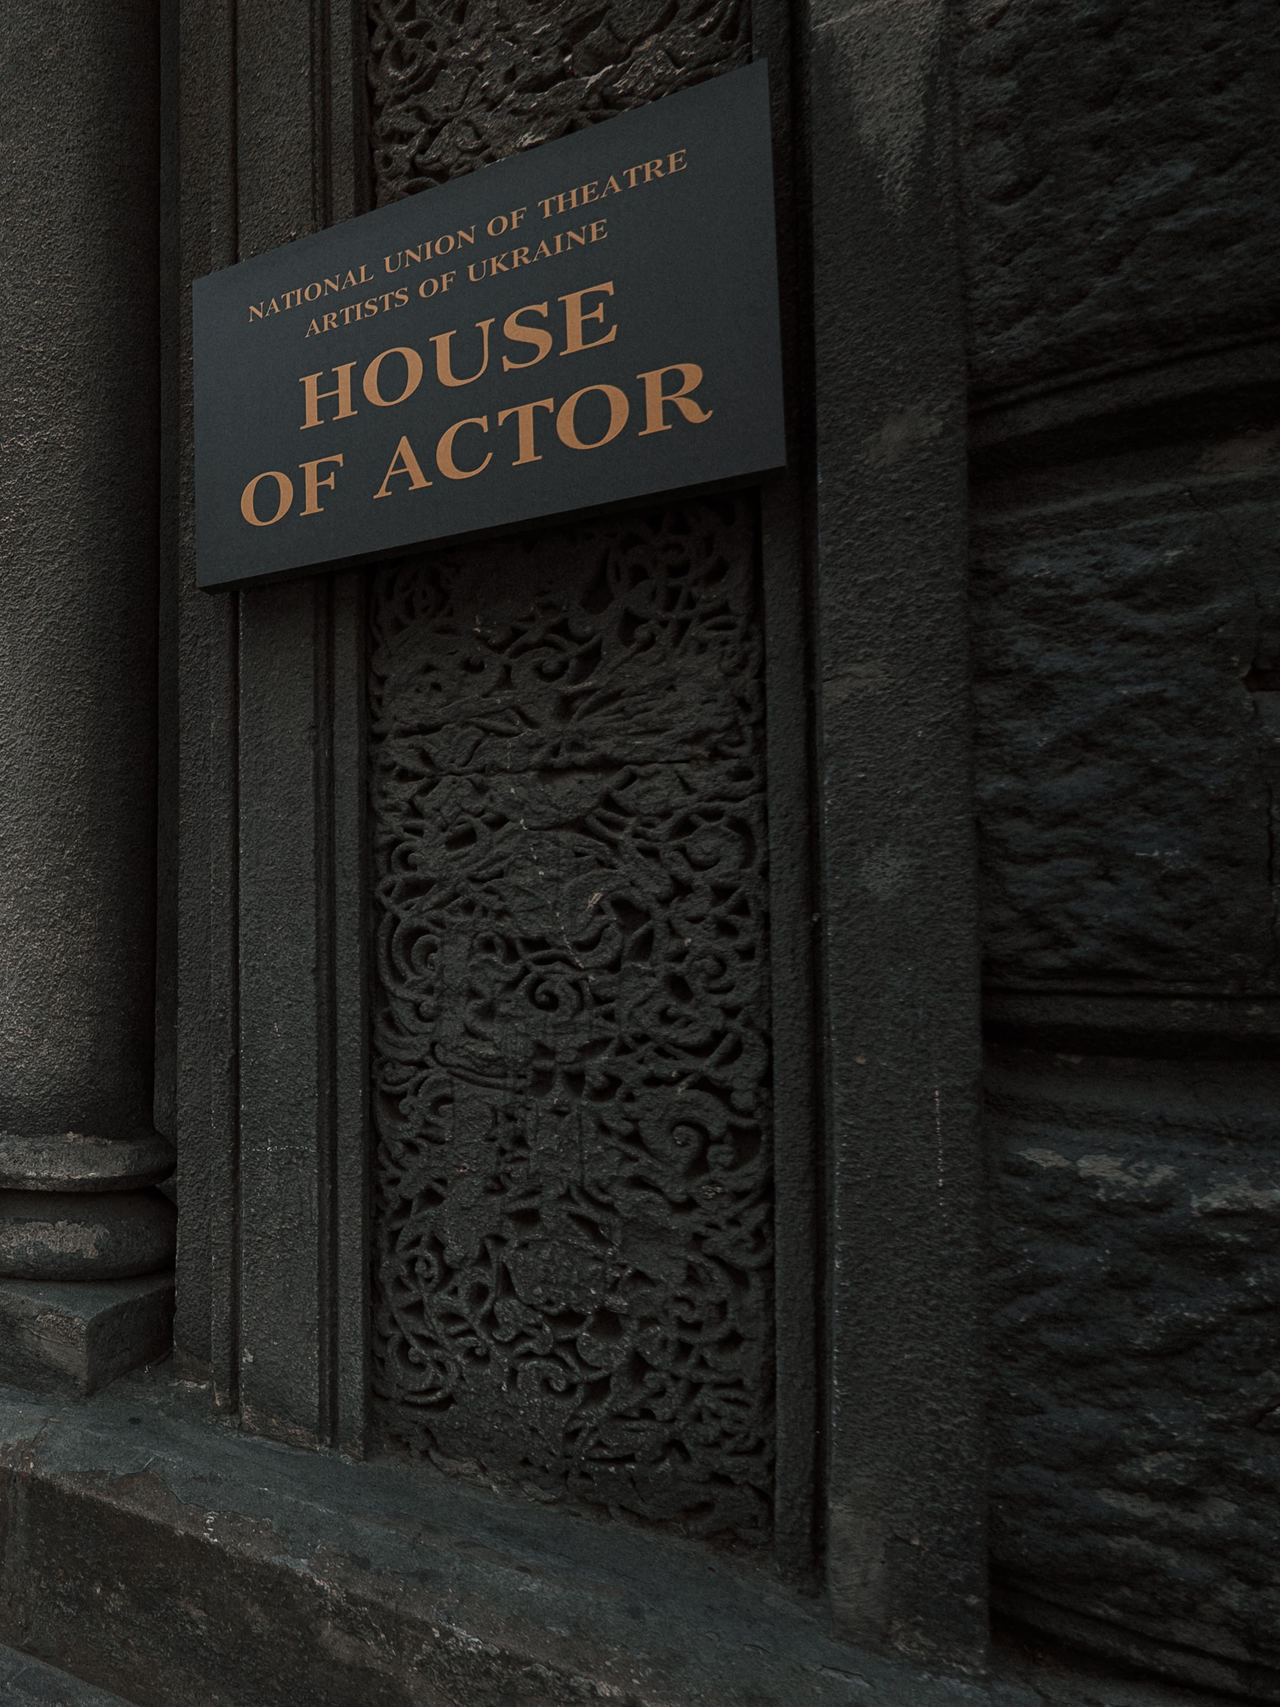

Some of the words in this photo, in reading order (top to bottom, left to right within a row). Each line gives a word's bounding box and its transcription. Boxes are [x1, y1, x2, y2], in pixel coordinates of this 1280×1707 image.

[248, 263, 374, 323] NATIONAL
[383, 225, 476, 275] UNION
[486, 207, 527, 238] OF
[536, 147, 688, 219] THEATRE
[304, 287, 410, 339] ARTISTS
[417, 271, 457, 300] OF
[466, 218, 609, 283] UKRAINE
[298, 280, 619, 431] HOUSE
[239, 452, 345, 528] OF
[372, 362, 714, 501] ACTOR
